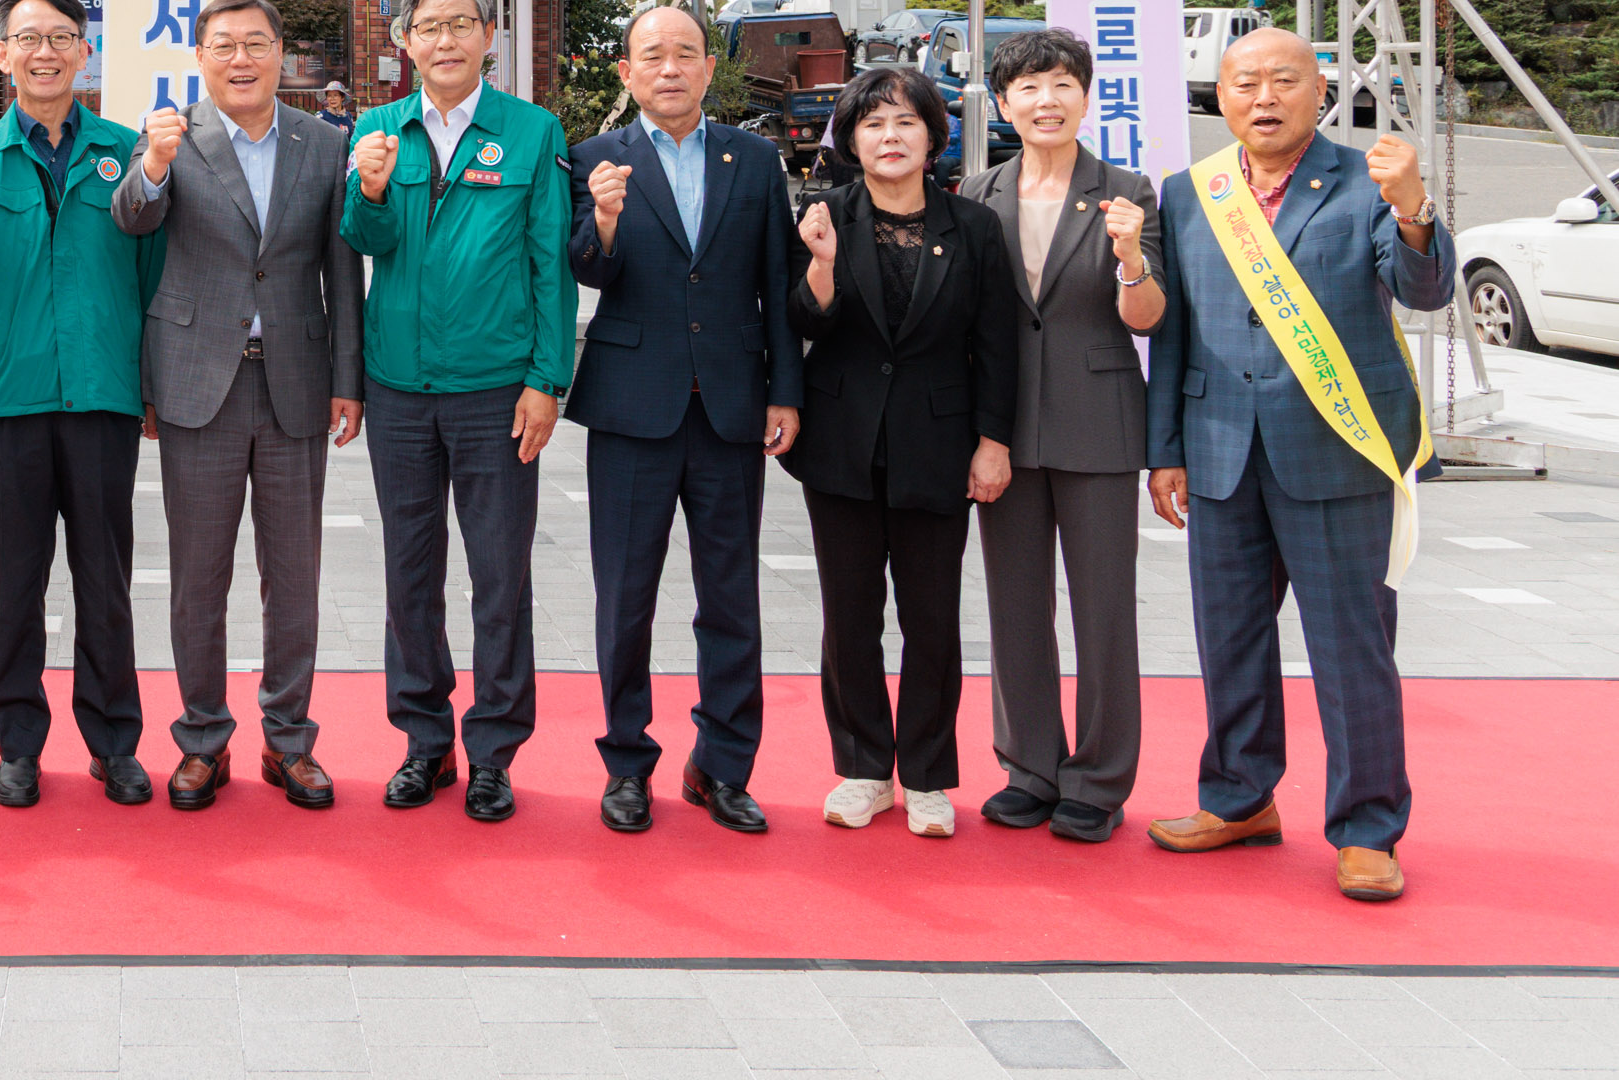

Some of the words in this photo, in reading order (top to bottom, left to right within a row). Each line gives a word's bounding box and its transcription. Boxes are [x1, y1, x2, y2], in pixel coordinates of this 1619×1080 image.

[382, 6, 389, 14] 23
[1098, 77, 1144, 170] 빛나
[1224, 206, 1272, 275] 전통시장이
[1261, 273, 1301, 320] 살아야
[1292, 319, 1343, 397] 서민경제가
